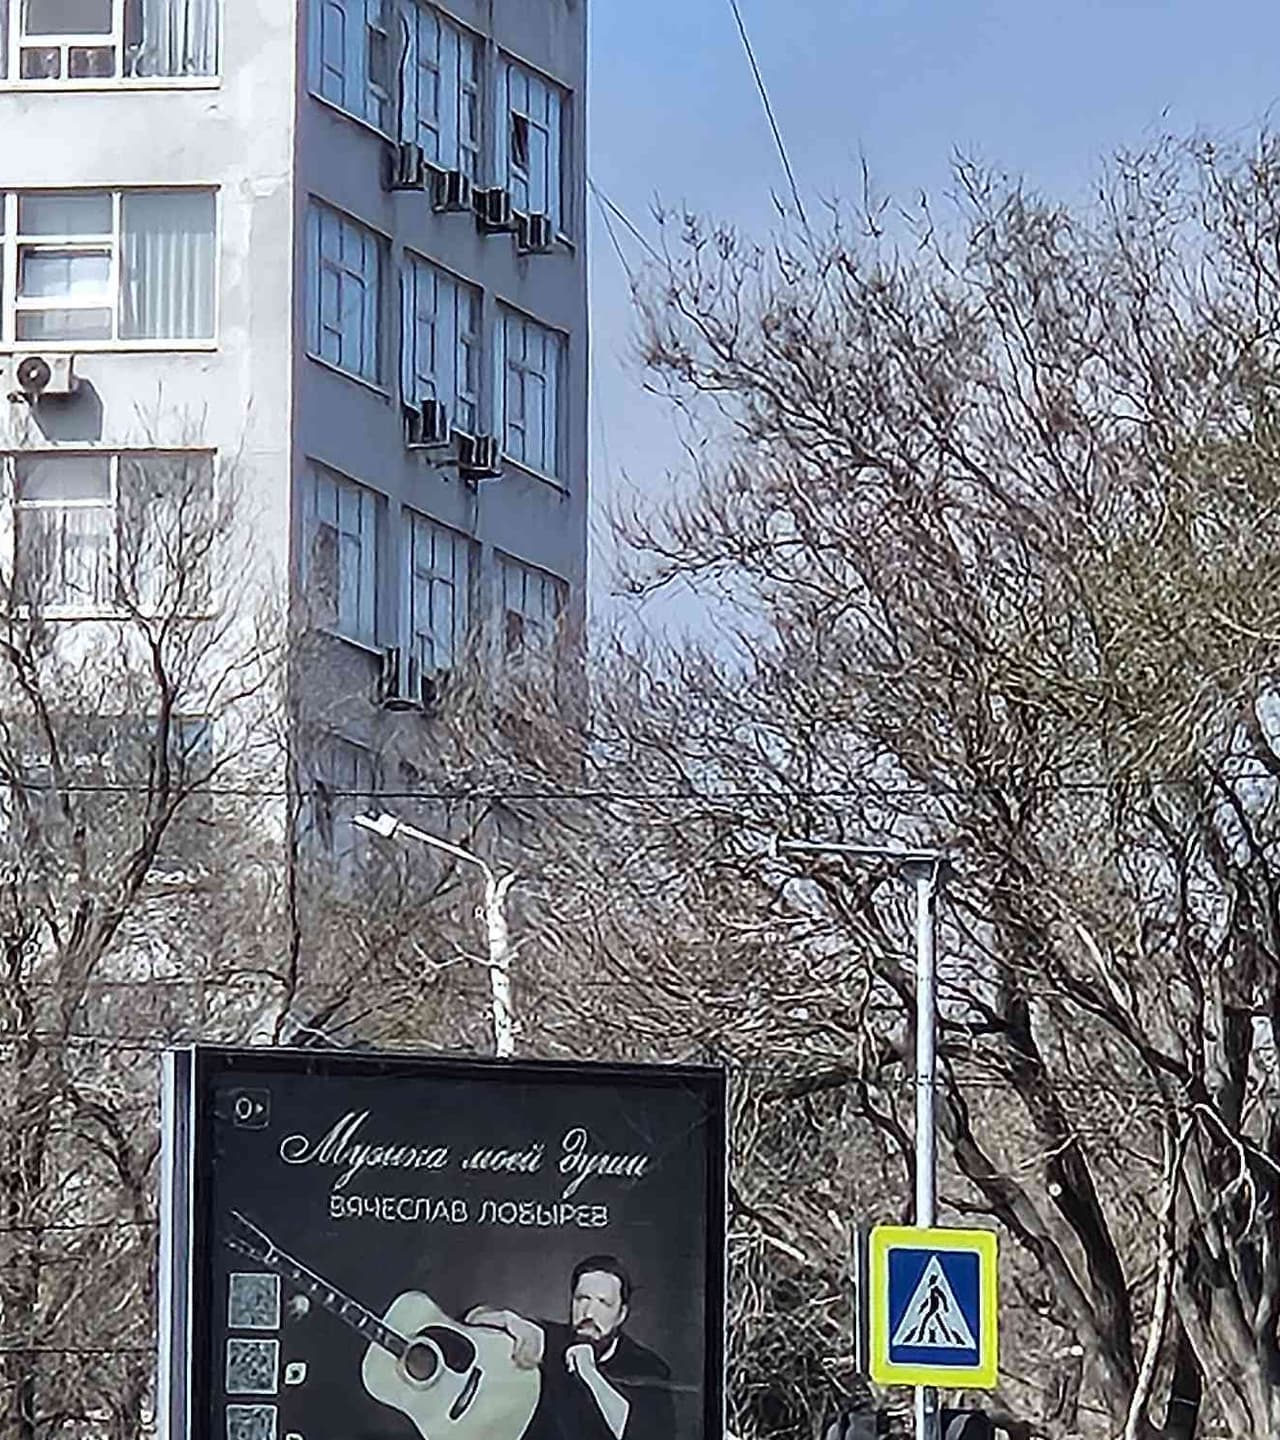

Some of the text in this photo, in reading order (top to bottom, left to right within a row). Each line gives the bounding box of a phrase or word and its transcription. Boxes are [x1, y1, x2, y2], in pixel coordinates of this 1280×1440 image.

[280, 1108, 649, 1200] Музыка моей души
[328, 1195, 608, 1228] ВЯЧЕСЛАВ ЛОБЫРЕВ
